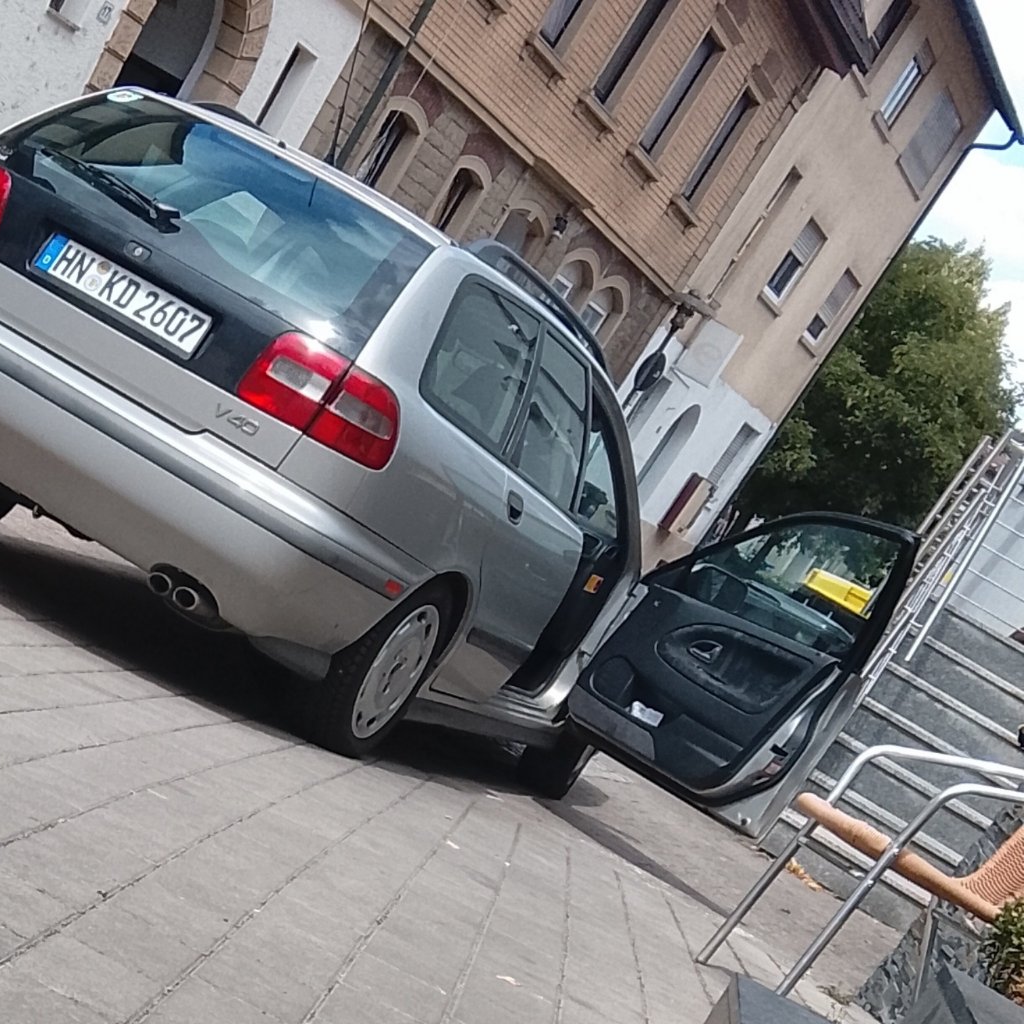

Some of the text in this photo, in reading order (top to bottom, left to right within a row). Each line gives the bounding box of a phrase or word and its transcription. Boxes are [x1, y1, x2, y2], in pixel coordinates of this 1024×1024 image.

[53, 245, 96, 284] HN
[97, 270, 141, 309] KD
[132, 290, 206, 343] 2607
[215, 402, 260, 437] V40
